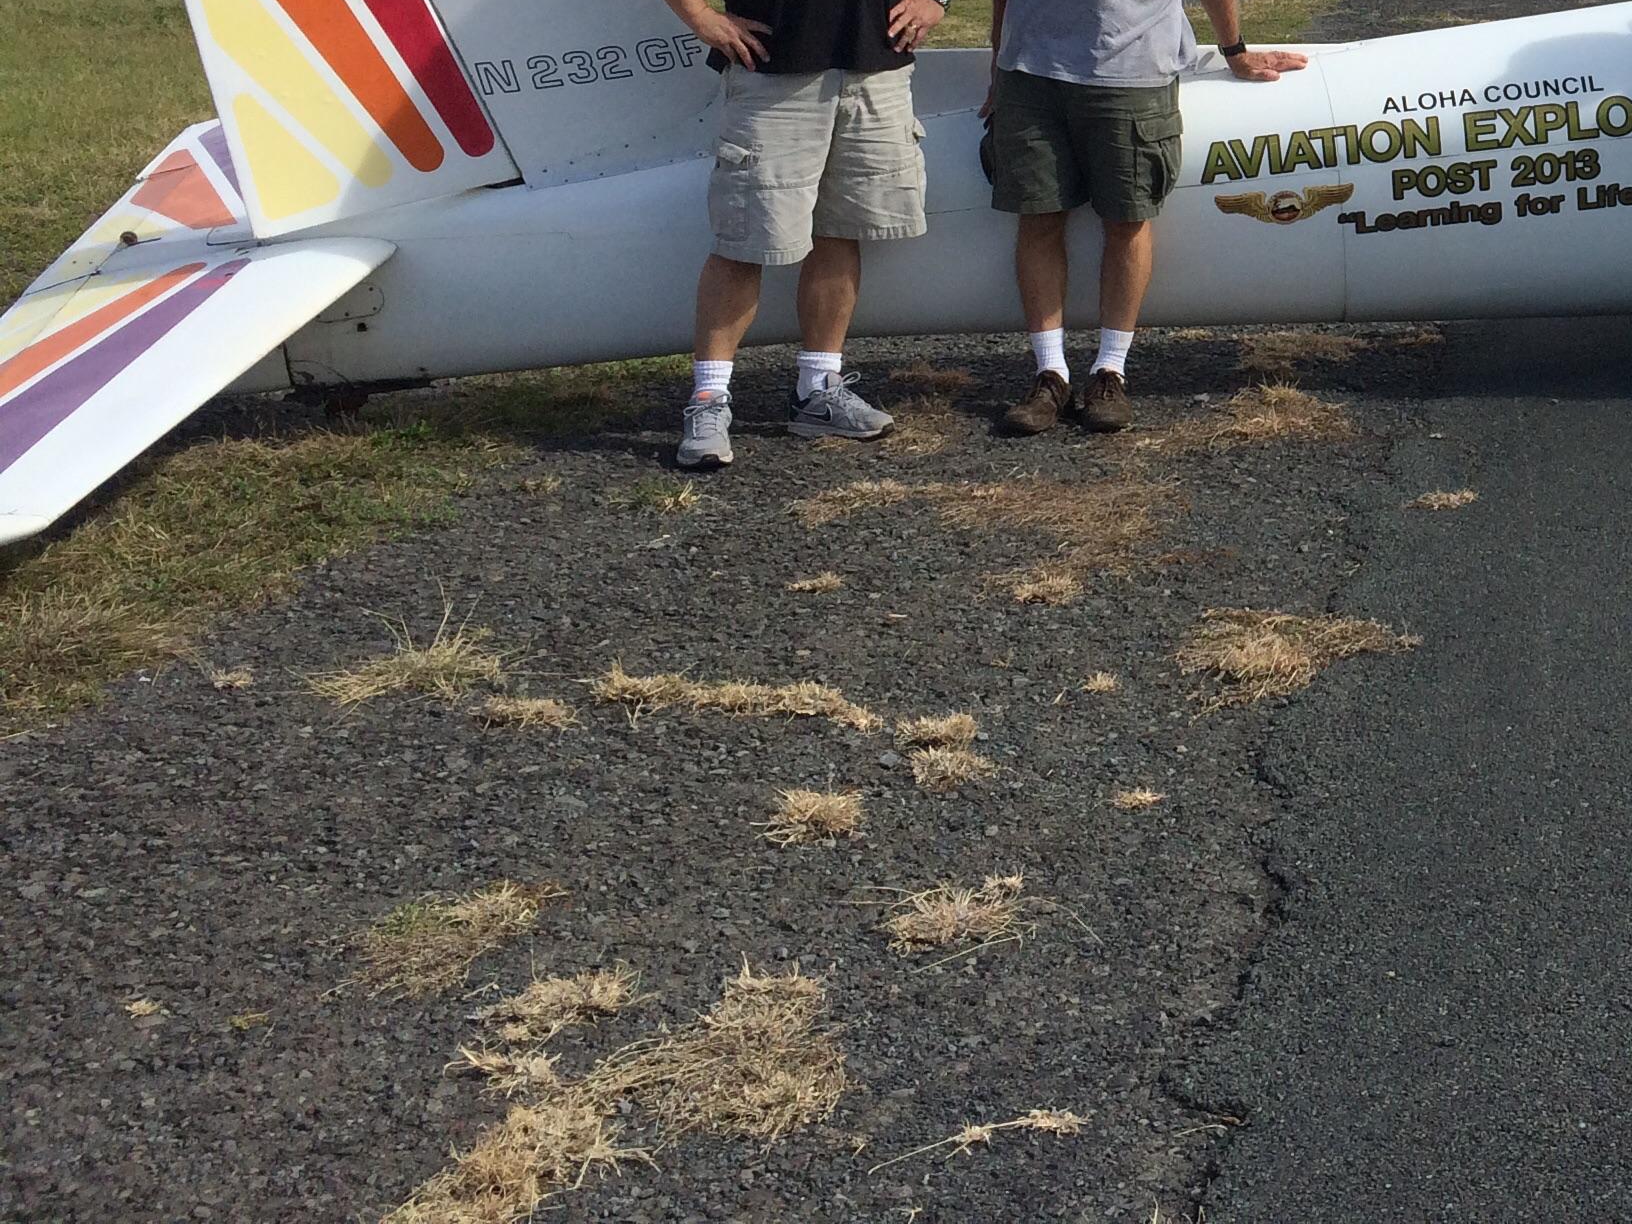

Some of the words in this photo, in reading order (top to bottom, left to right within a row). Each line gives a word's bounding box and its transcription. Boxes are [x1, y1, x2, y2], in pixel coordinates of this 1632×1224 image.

[1382, 88, 1478, 115] ALOHA
[1483, 75, 1605, 103] COUNCIL
[1200, 116, 1442, 185] AVIATION
[1392, 159, 1498, 200] POST
[1511, 147, 1601, 188] 2013
[1514, 192, 1566, 217] for
